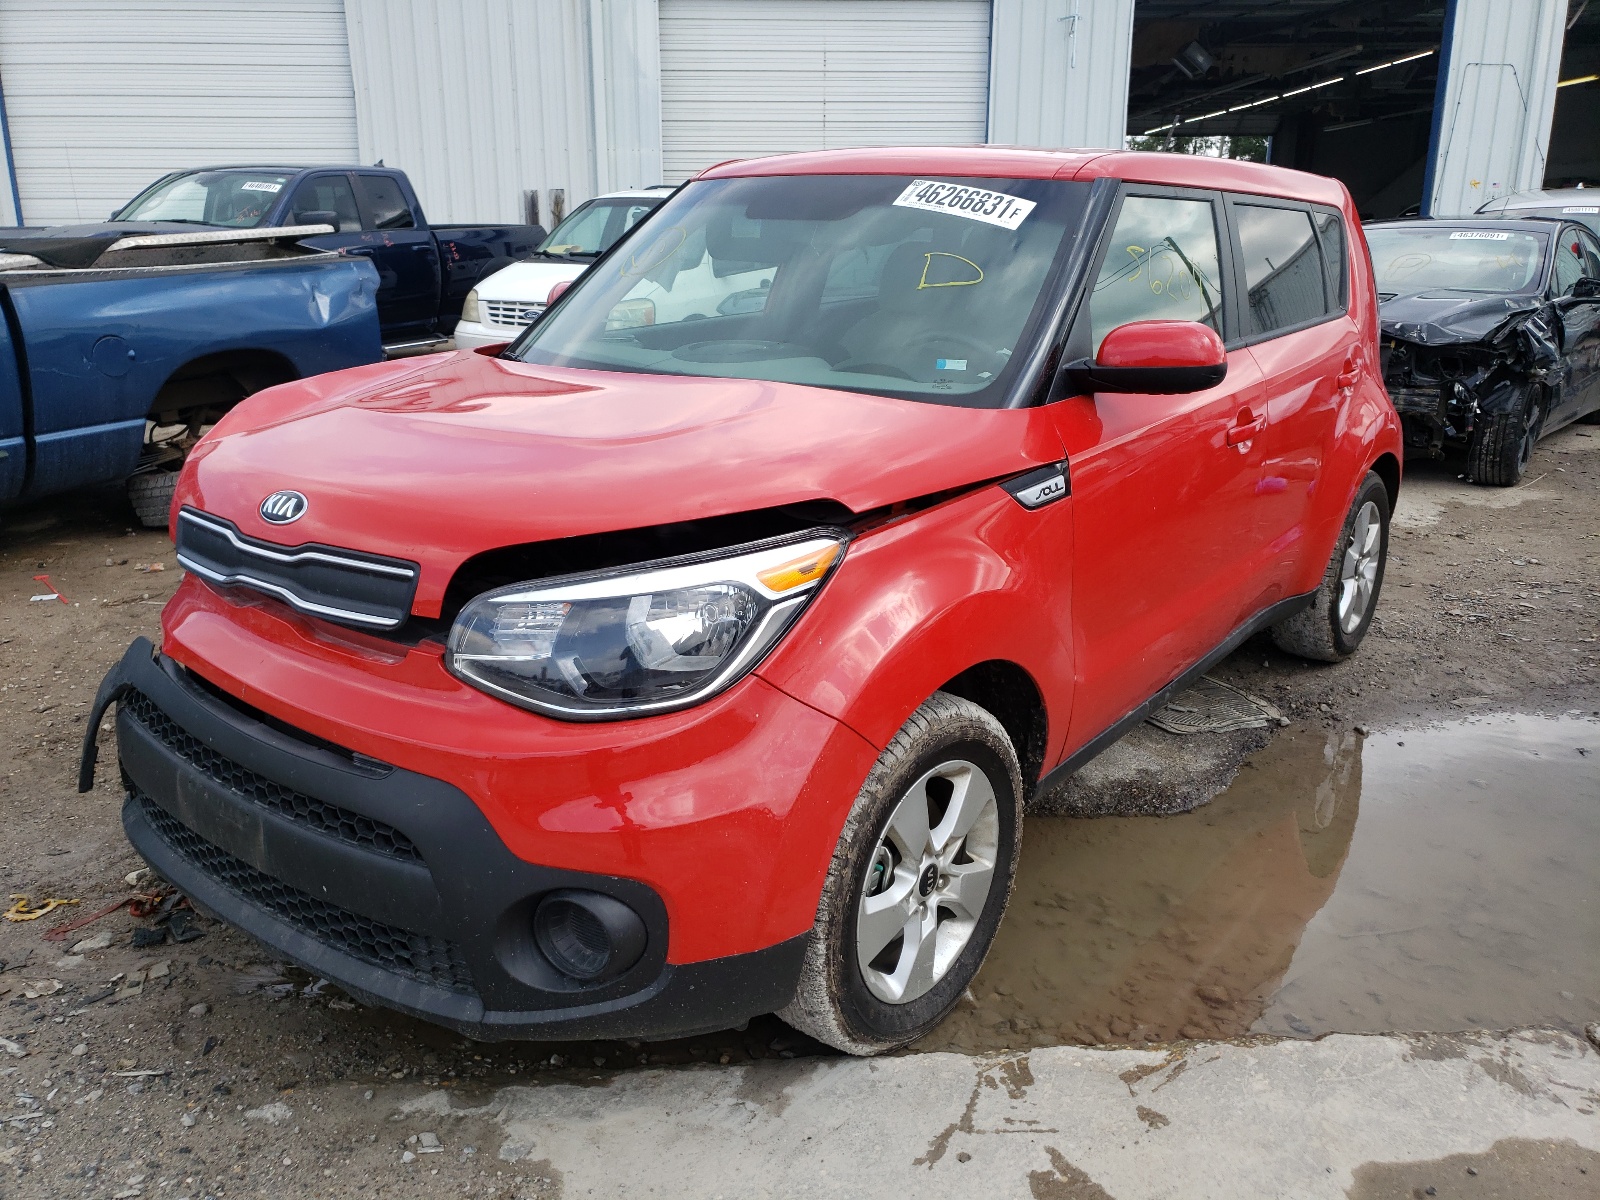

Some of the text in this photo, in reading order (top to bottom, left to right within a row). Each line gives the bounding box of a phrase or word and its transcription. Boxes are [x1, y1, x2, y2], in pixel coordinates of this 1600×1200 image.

[915, 183, 1015, 219] 46266831
[916, 252, 984, 290] D
[262, 494, 298, 518] KIA
[925, 866, 934, 894] KIA
